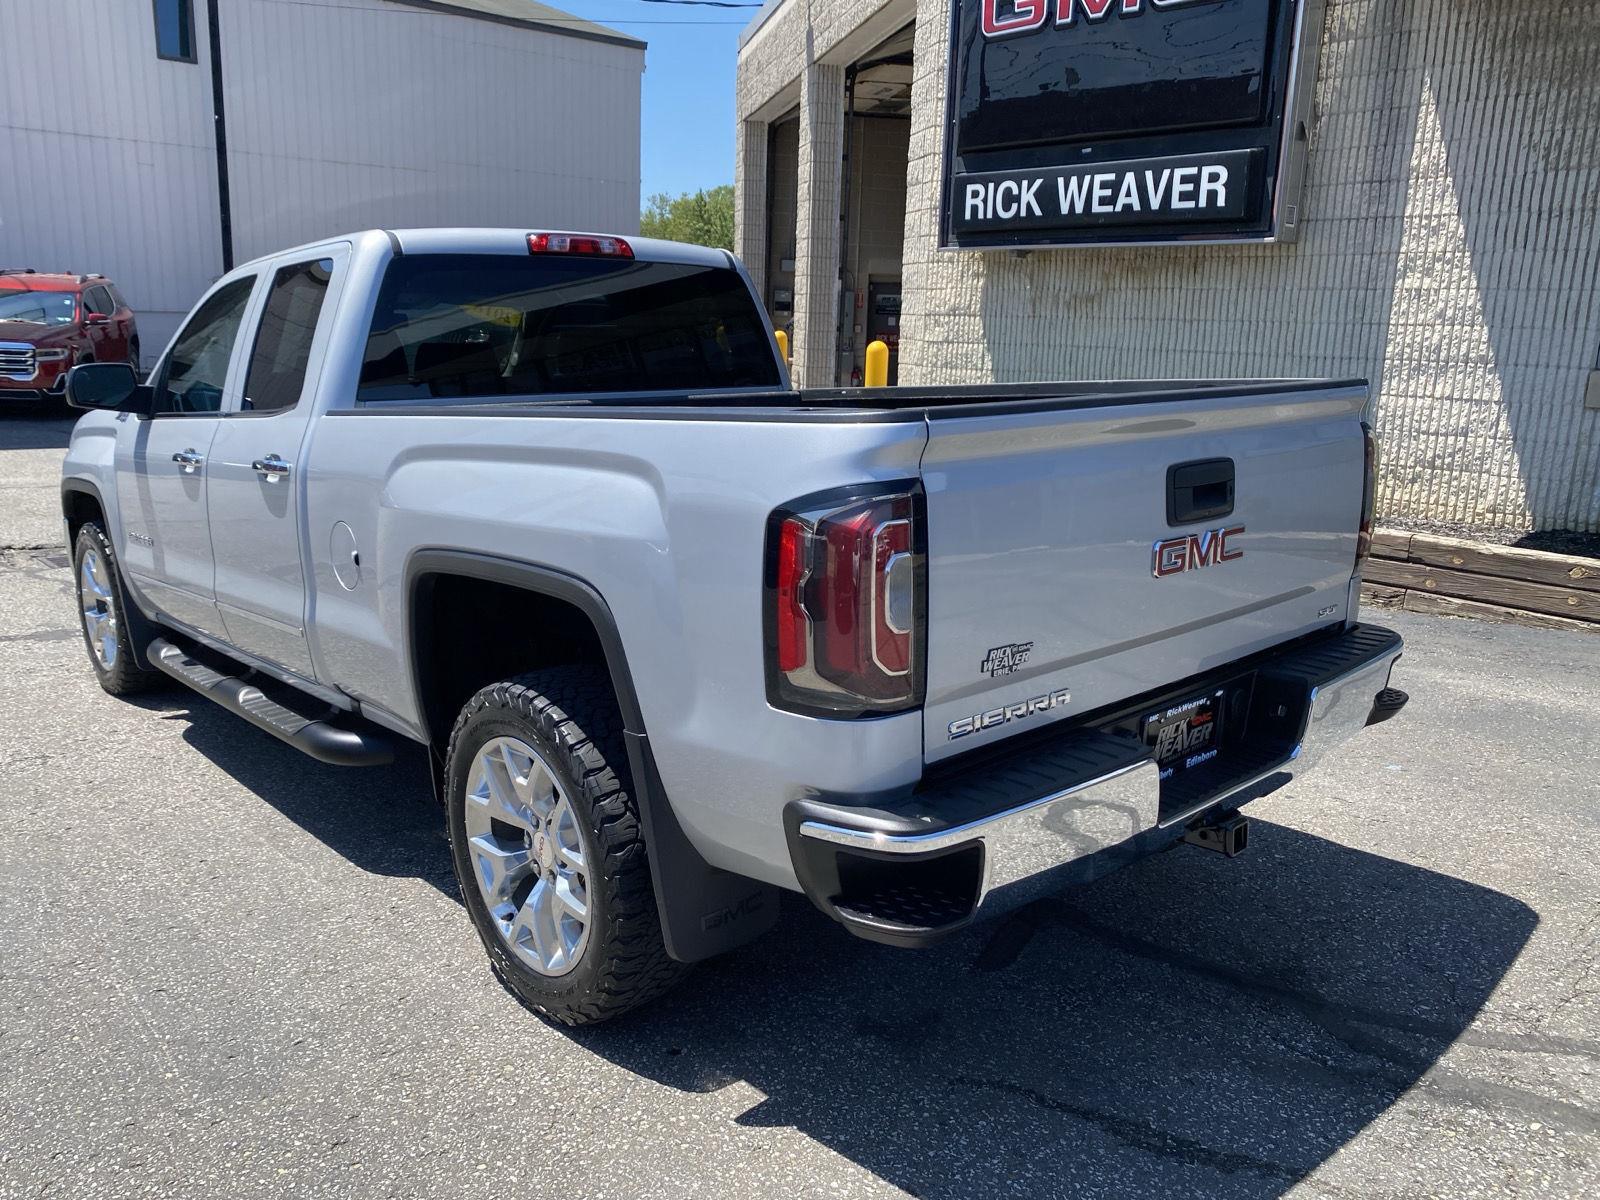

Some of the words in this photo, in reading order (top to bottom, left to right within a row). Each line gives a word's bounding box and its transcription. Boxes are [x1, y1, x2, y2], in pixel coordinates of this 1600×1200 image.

[964, 178, 1043, 220] RICK
[1057, 165, 1229, 214] WEAVER
[1153, 525, 1245, 577] GMC
[982, 650, 1030, 672] WEAVER
[988, 646, 1012, 660] RICK
[948, 689, 1071, 740] SIERRA
[1158, 717, 1190, 742] RICK
[1186, 749, 1218, 769] Edinboro
